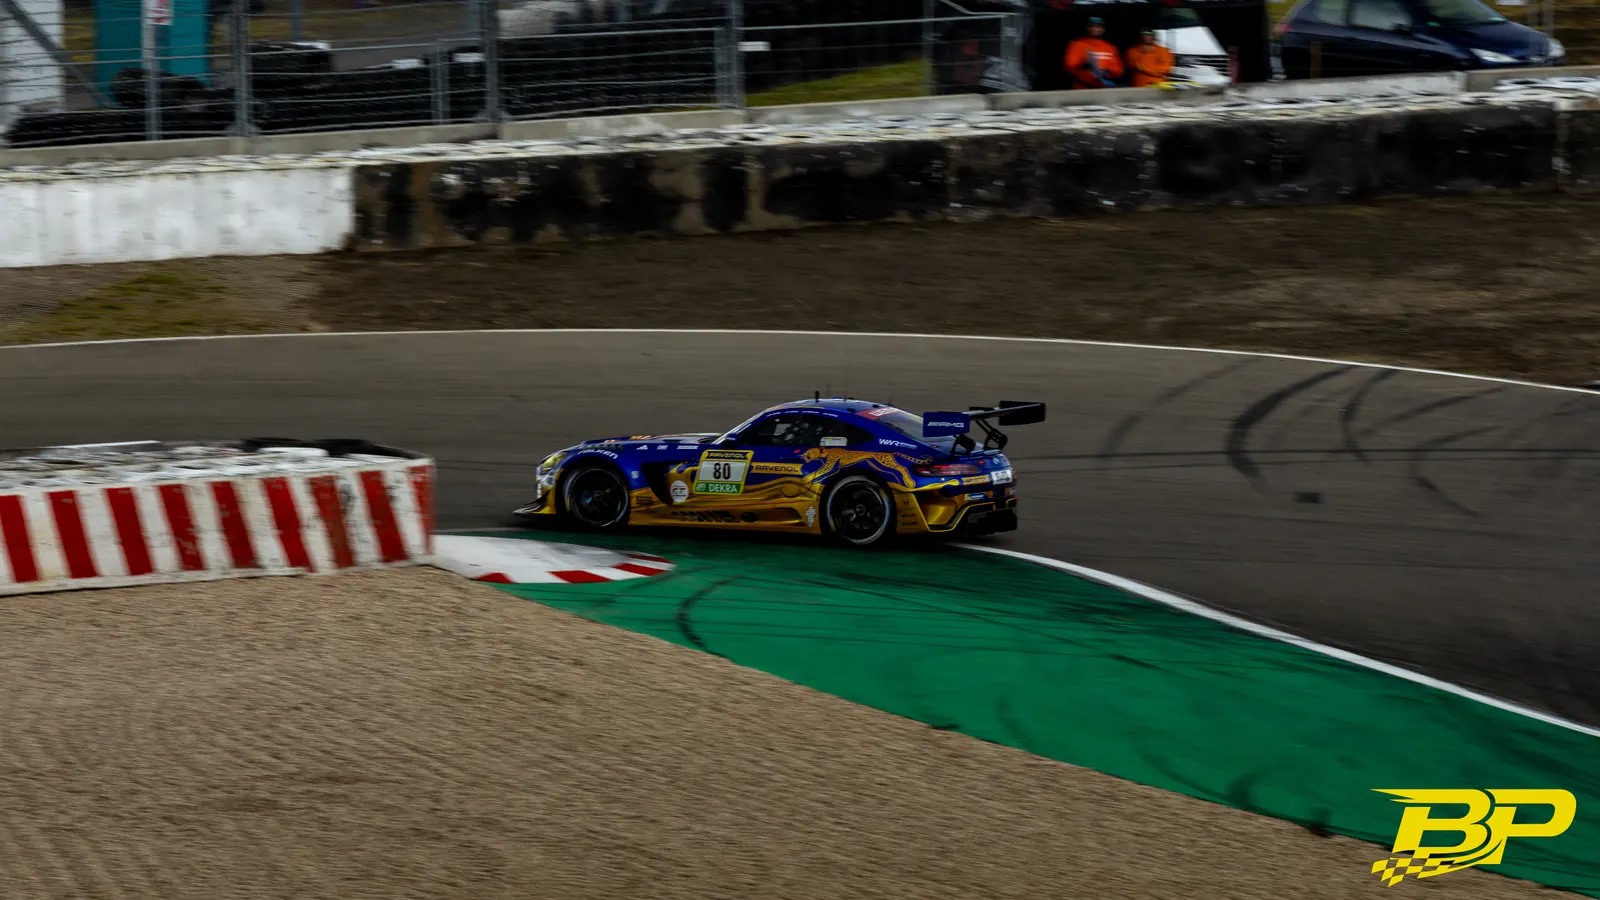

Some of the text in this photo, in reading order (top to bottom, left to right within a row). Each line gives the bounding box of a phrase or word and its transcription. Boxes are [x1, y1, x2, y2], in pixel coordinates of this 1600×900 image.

[713, 462, 731, 480] 80
[755, 464, 799, 472] RAVENOL
[708, 484, 738, 493] DEKRA
